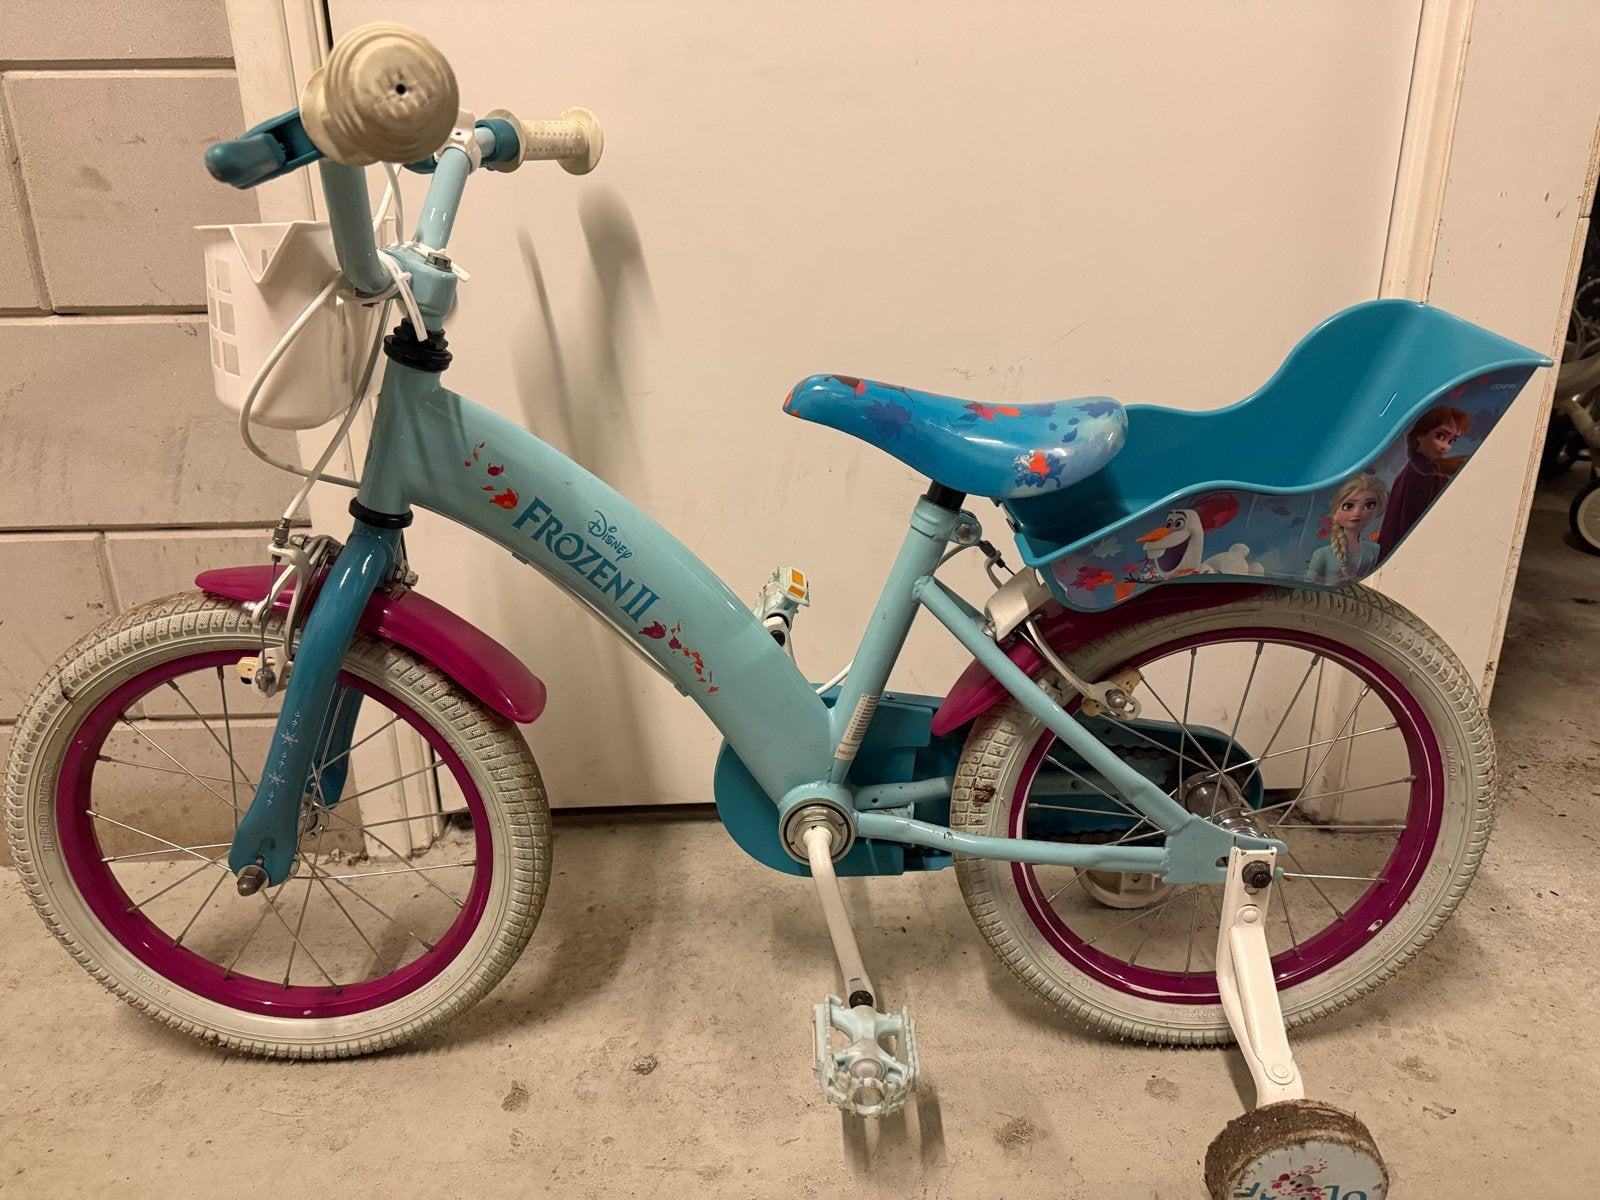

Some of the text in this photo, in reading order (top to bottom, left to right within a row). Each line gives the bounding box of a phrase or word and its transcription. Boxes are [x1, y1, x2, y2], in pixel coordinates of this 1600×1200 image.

[512, 497, 661, 622] FROZEN II
[133, 970, 170, 996] NYLON
